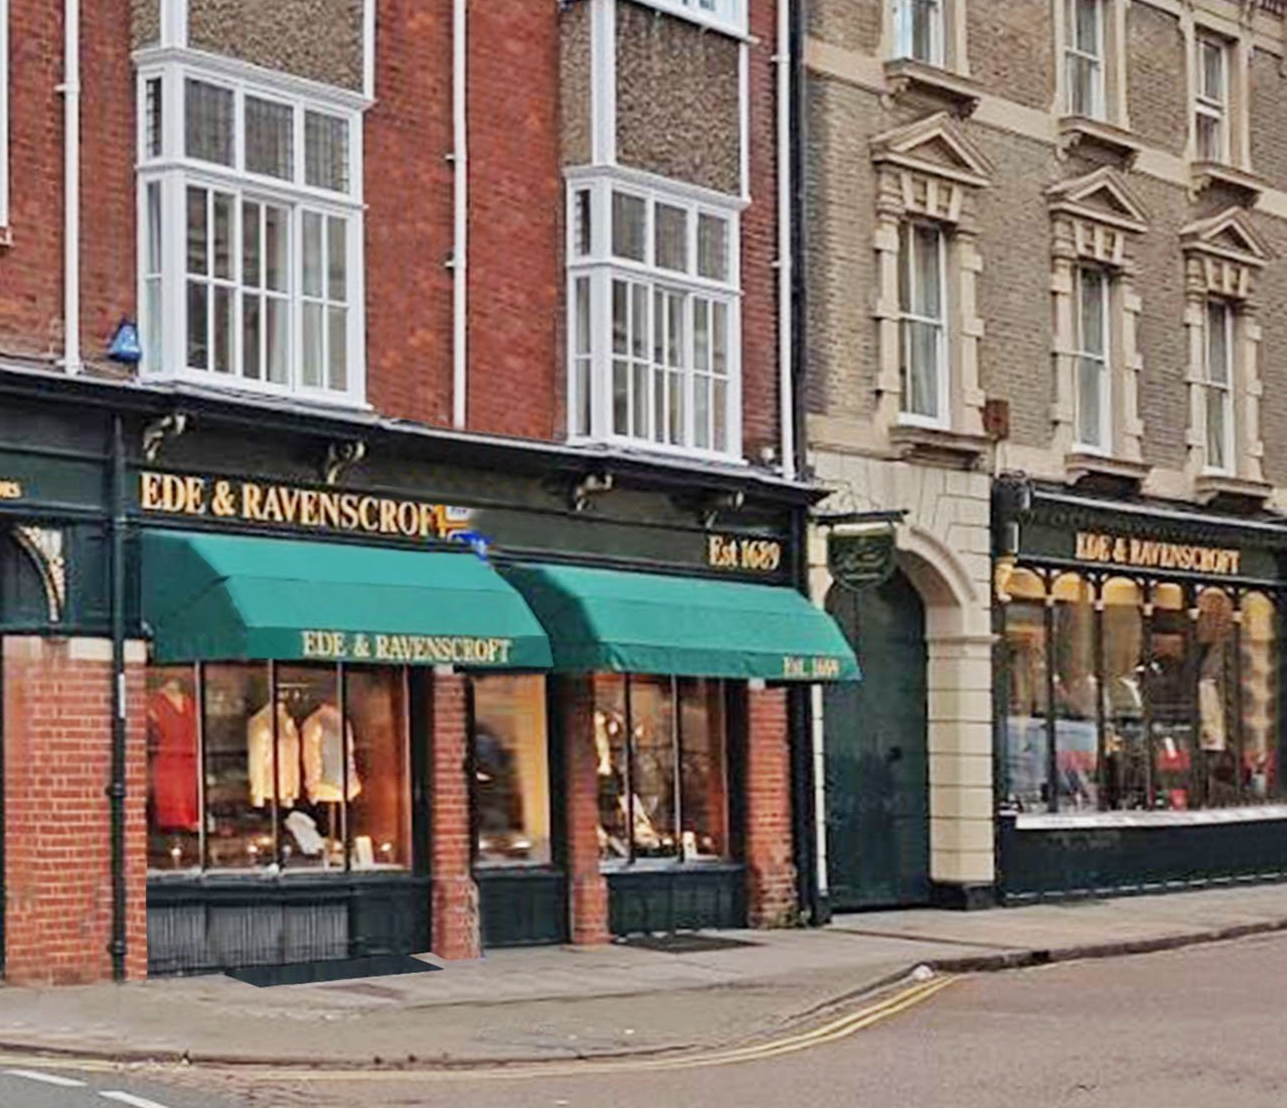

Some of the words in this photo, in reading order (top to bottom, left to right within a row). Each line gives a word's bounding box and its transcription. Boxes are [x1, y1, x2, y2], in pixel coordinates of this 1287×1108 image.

[141, 471, 206, 515] EDE
[212, 480, 235, 516] &
[741, 539, 781, 571] 1689
[1075, 532, 1110, 561] EDE
[1113, 538, 1125, 562] &
[1130, 539, 1240, 574] RAVENSCROFT
[302, 630, 348, 657] EDE
[353, 632, 369, 657] &
[376, 635, 513, 664] RAVENSCROFT
